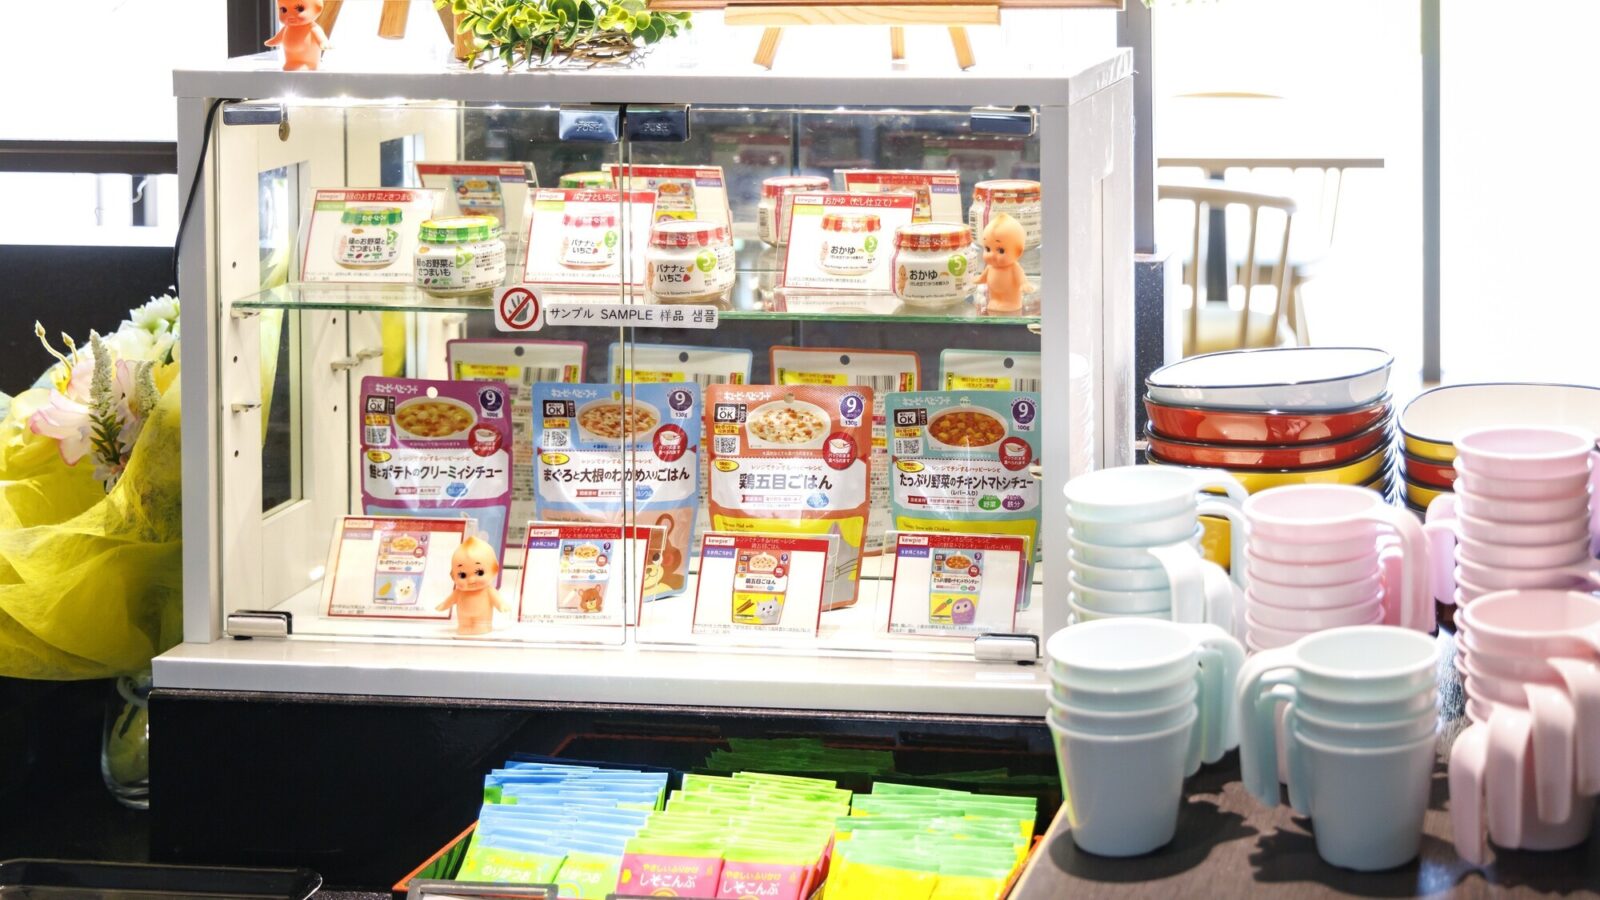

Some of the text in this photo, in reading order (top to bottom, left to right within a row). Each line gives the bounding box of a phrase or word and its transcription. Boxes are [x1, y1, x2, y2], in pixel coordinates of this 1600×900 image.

[830, 246, 856, 255] おかゆ
[656, 263, 685, 273] バナナと
[659, 273, 682, 283] いちご
[909, 270, 938, 281] おかゆ
[551, 308, 594, 320] サンプル
[600, 309, 653, 321] SAMPLE
[692, 311, 716, 323] 샘플
[719, 411, 733, 419] OK
[899, 416, 913, 424] OK
[543, 467, 690, 483] まぐろと大根のわかめ入りごはん
[739, 473, 832, 490] 鶏五目ごはん
[900, 474, 1034, 491] たっぷり野菜のチキントマトシチュー
[640, 872, 697, 889] しそこんぶ
[723, 880, 780, 896] しそこんぶ
